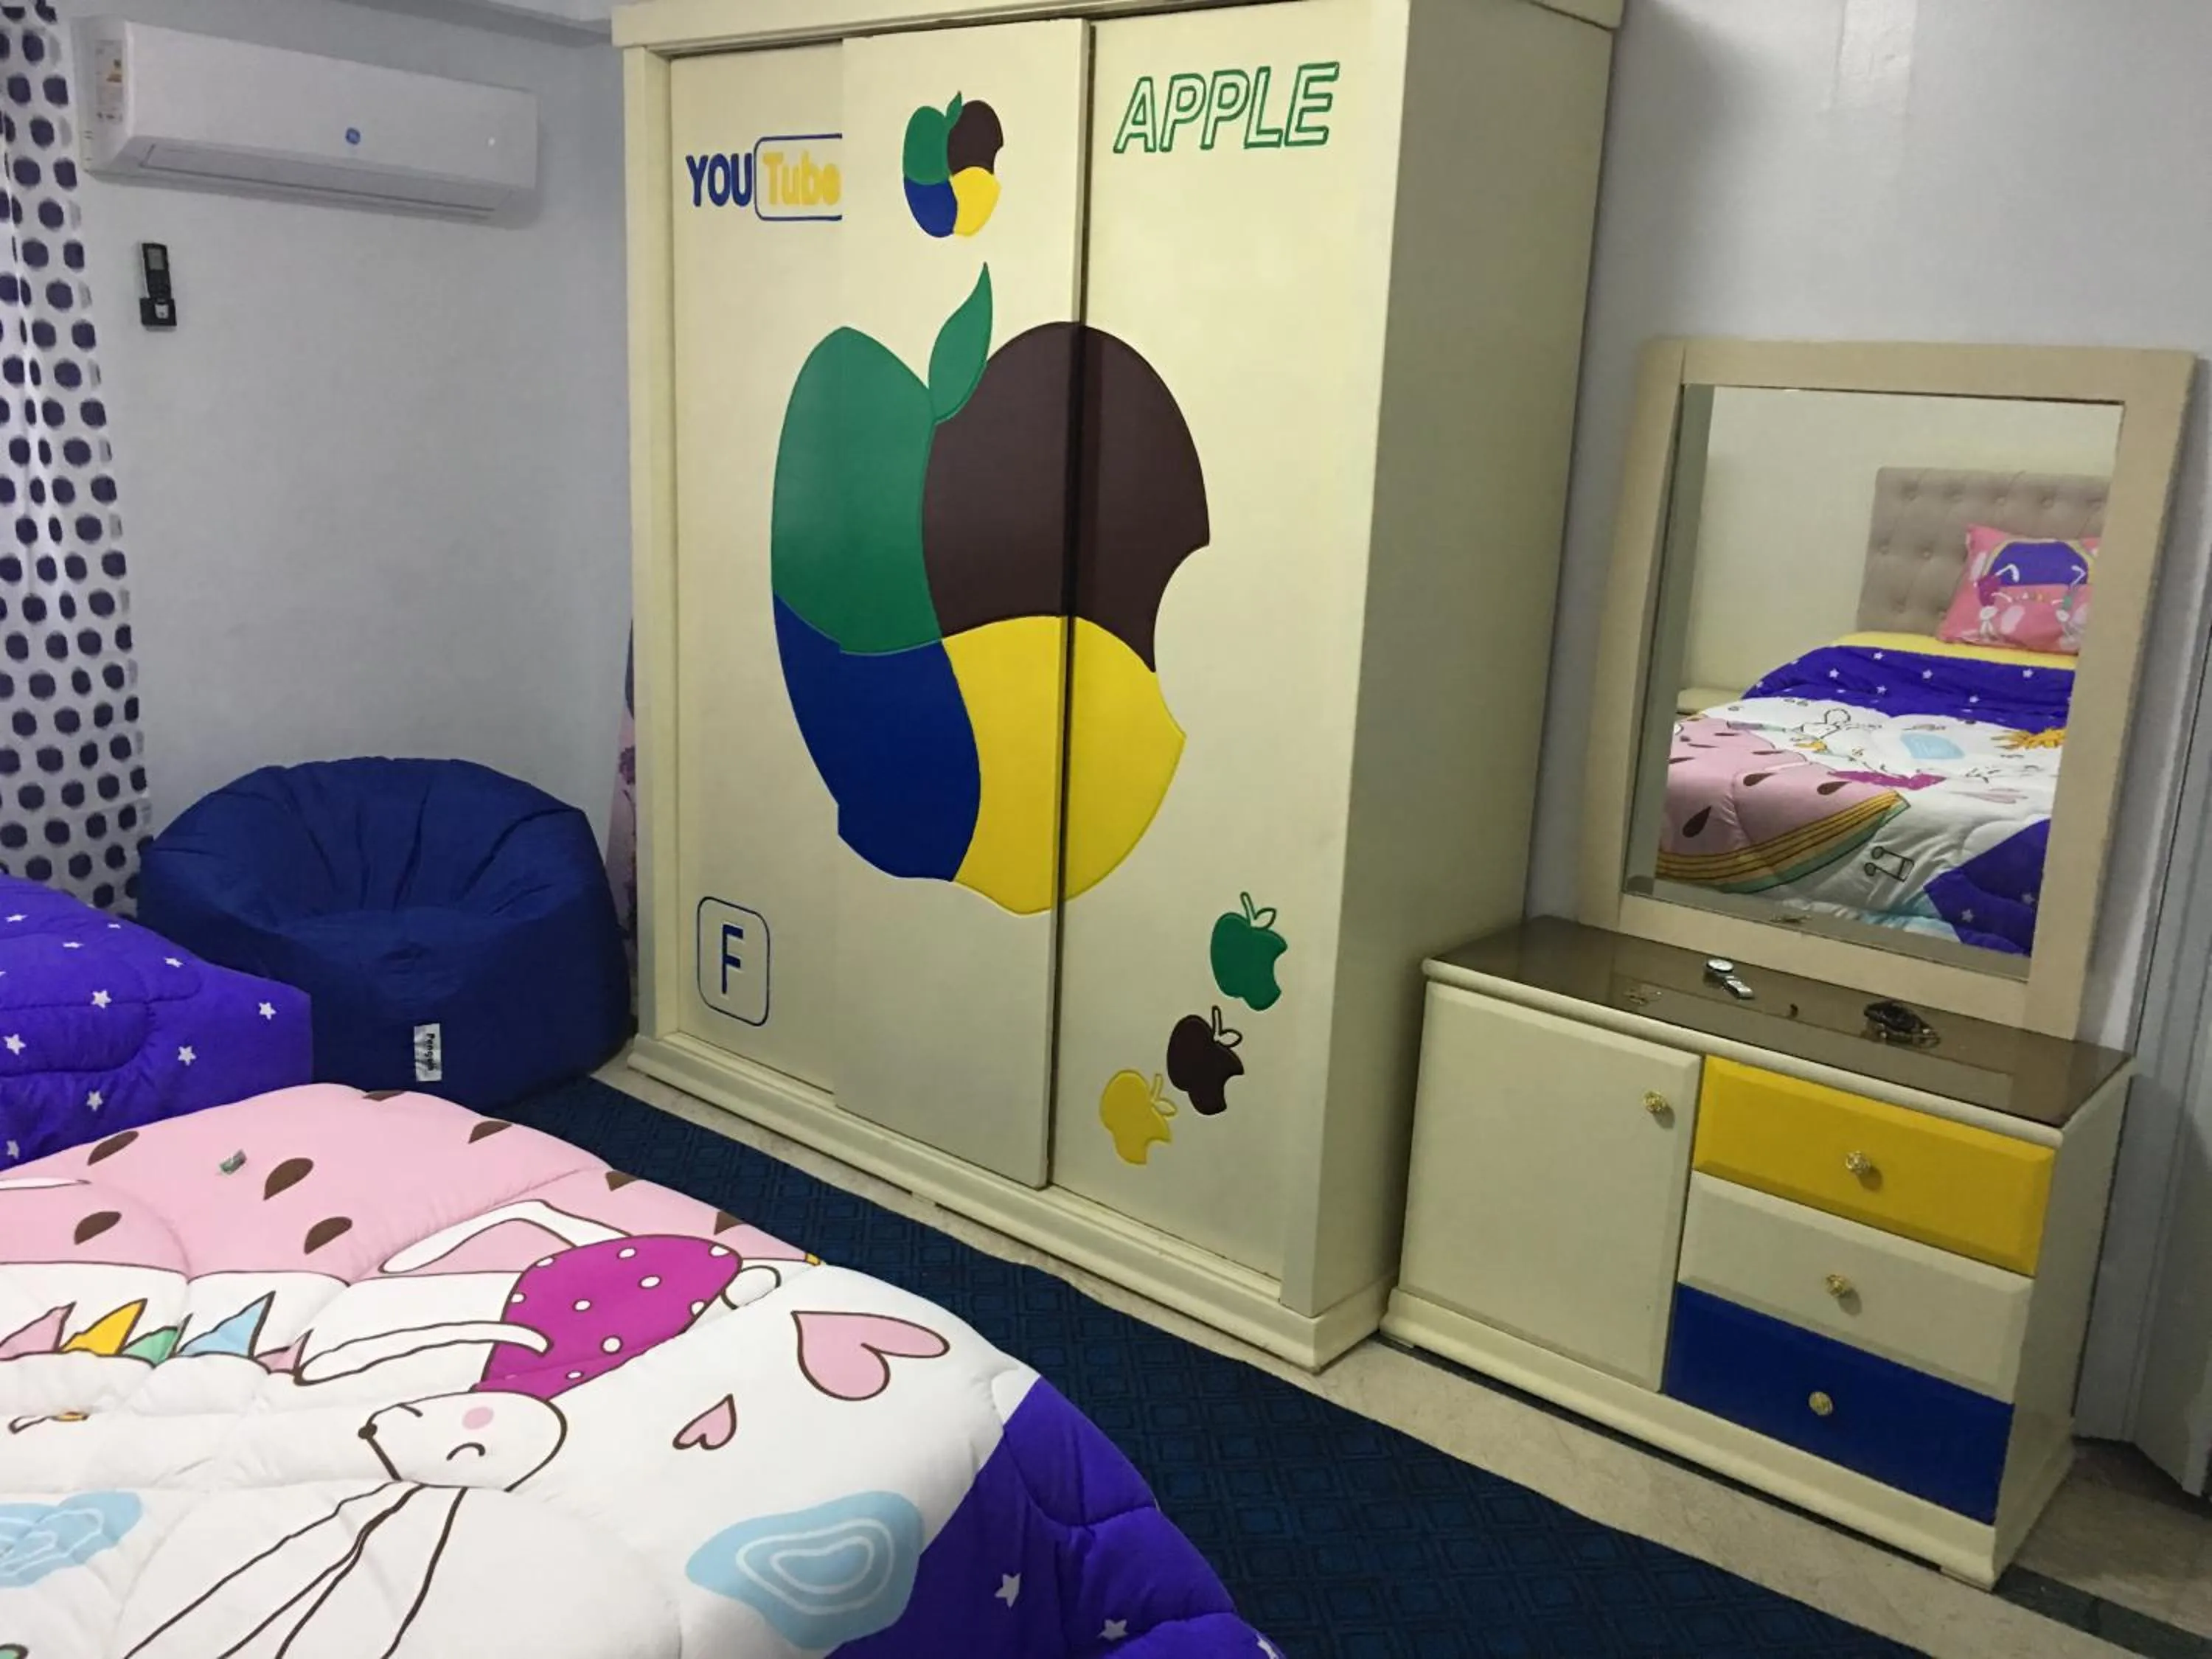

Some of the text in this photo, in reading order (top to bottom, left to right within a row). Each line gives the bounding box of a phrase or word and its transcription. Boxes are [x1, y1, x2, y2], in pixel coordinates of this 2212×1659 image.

[1113, 62, 1340, 153] APPLE
[686, 150, 841, 207] YOU Tube
[722, 924, 743, 994] F
